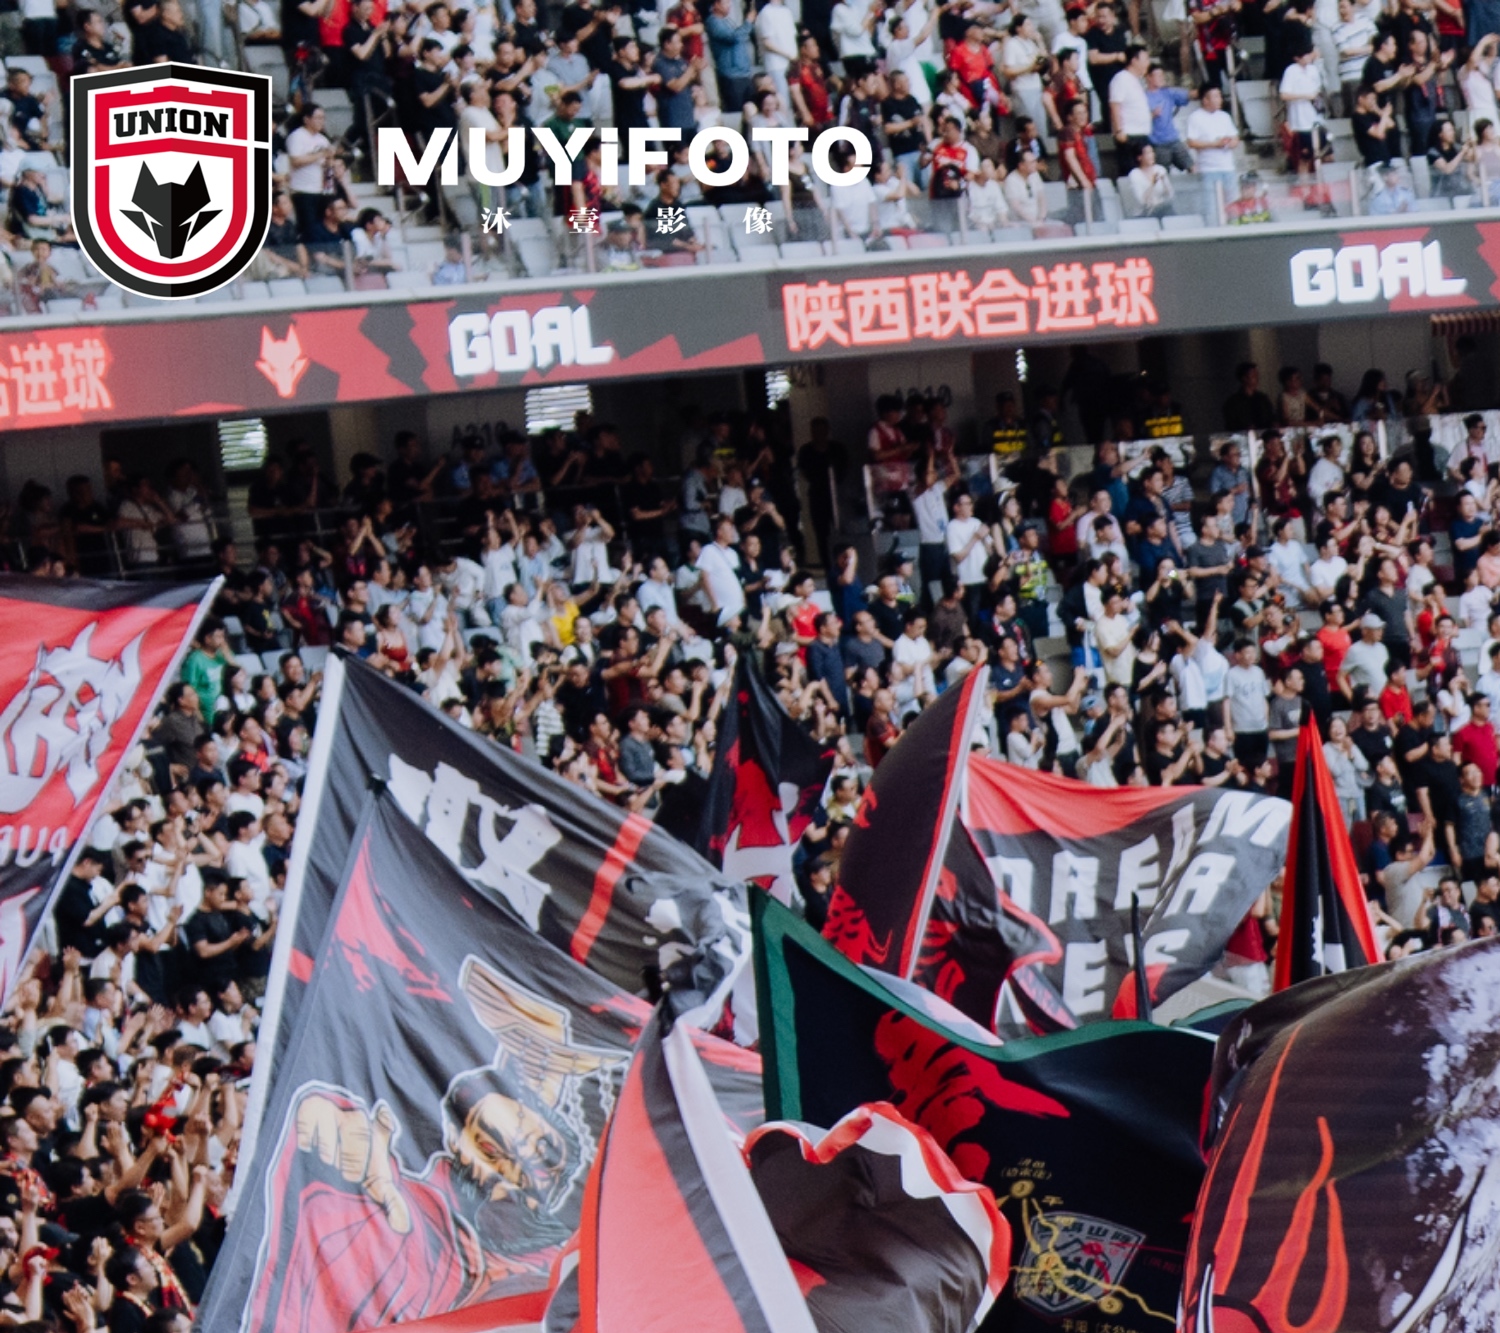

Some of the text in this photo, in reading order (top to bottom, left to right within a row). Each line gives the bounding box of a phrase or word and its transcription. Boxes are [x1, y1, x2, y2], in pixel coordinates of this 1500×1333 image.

[783, 258, 1158, 350] 陕西联合进球
[1290, 239, 1468, 309] GOAL
[0, 340, 113, 416] 进球
[448, 308, 613, 378] GOAL
